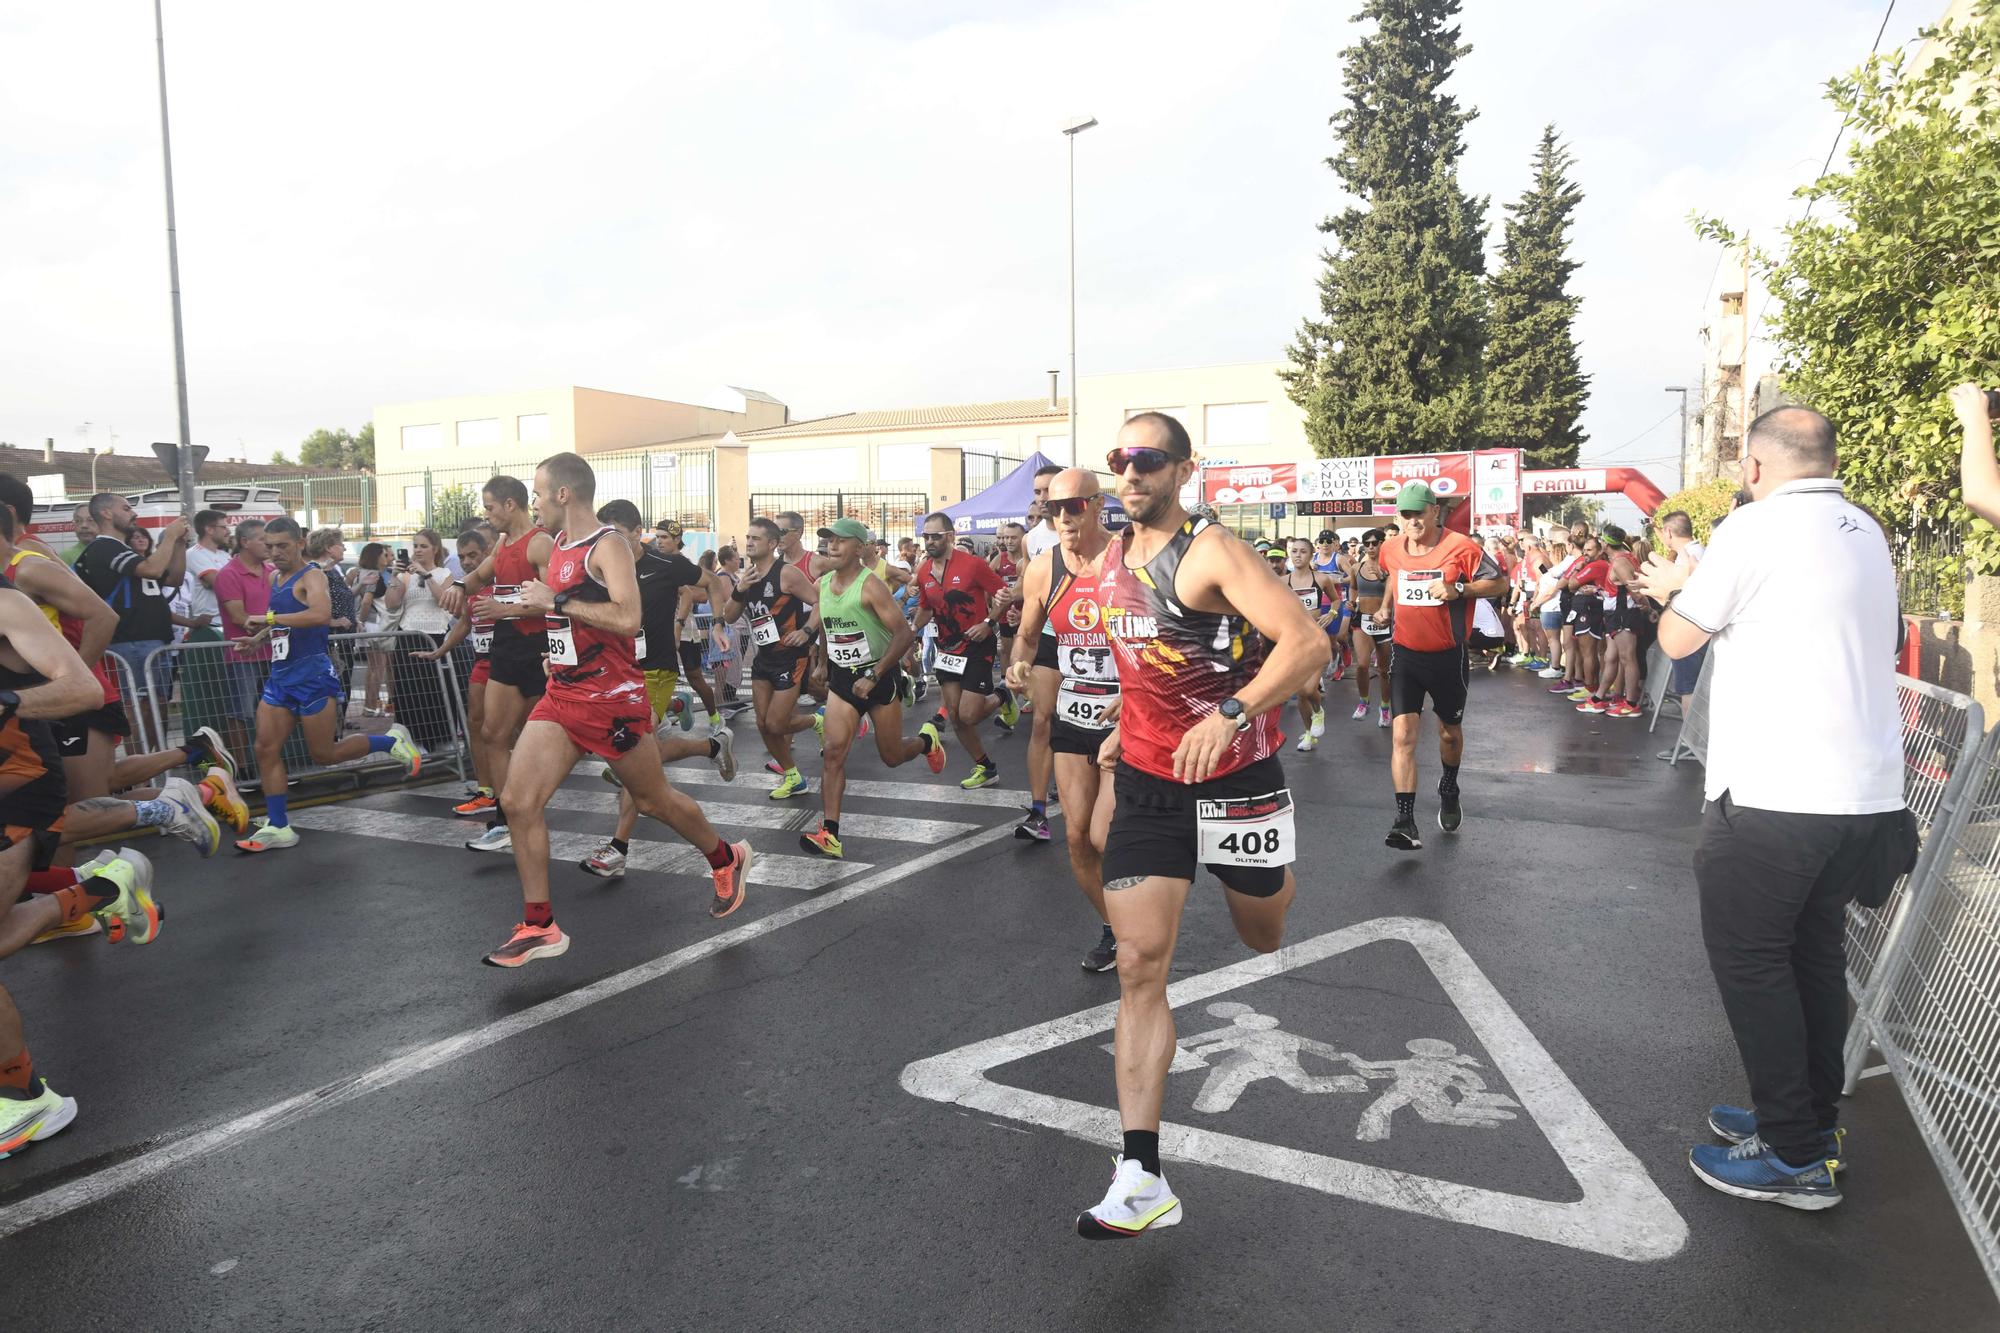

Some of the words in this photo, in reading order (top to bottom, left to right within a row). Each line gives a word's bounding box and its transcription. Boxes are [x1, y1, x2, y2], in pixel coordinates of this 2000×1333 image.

[1320, 459, 1368, 471] XXVIII
[1321, 470, 1368, 480] NON
[1321, 478, 1369, 490] DUER
[1321, 487, 1369, 498] MAS
[1272, 502, 1284, 518] P
[834, 647, 862, 661] 354
[1068, 701, 1107, 720] 492
[1218, 828, 1280, 855] 408
